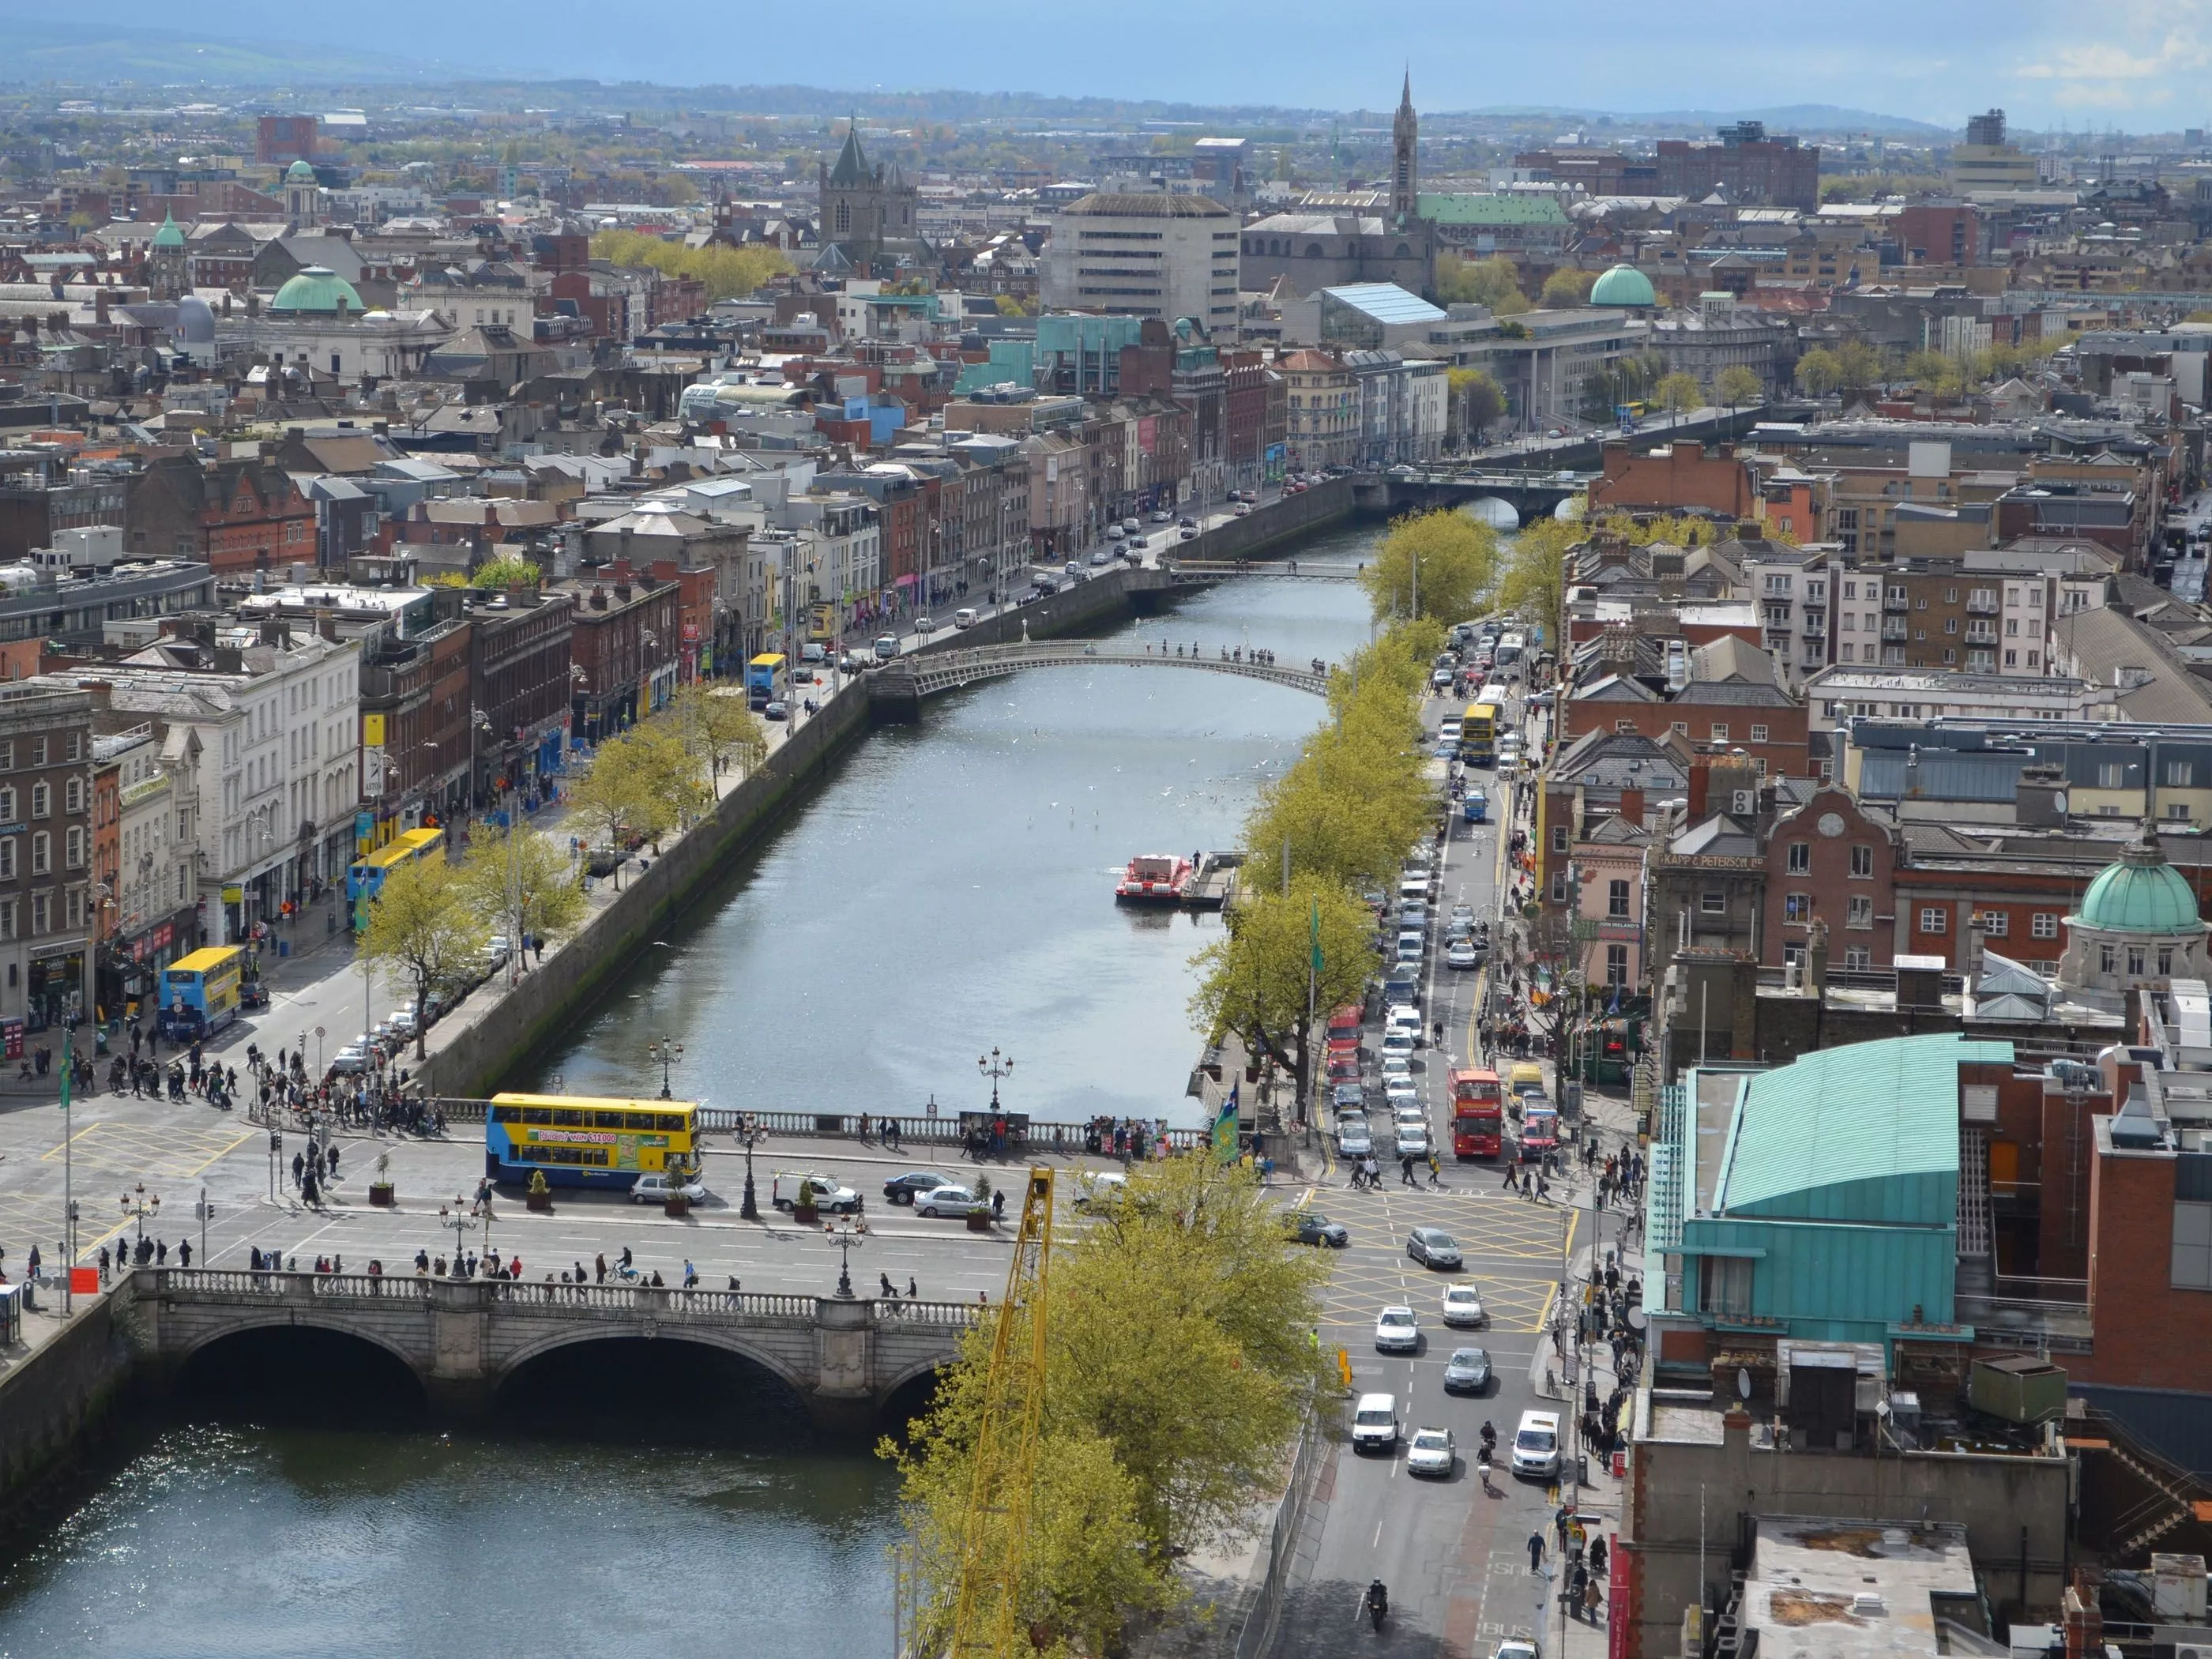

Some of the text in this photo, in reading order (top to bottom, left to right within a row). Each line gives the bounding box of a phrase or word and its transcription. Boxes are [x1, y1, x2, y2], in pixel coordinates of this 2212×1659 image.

[1664, 854, 1690, 866] KAPP
[1701, 856, 1747, 867] PETERSON
[1483, 1622, 1533, 1638] BUS
